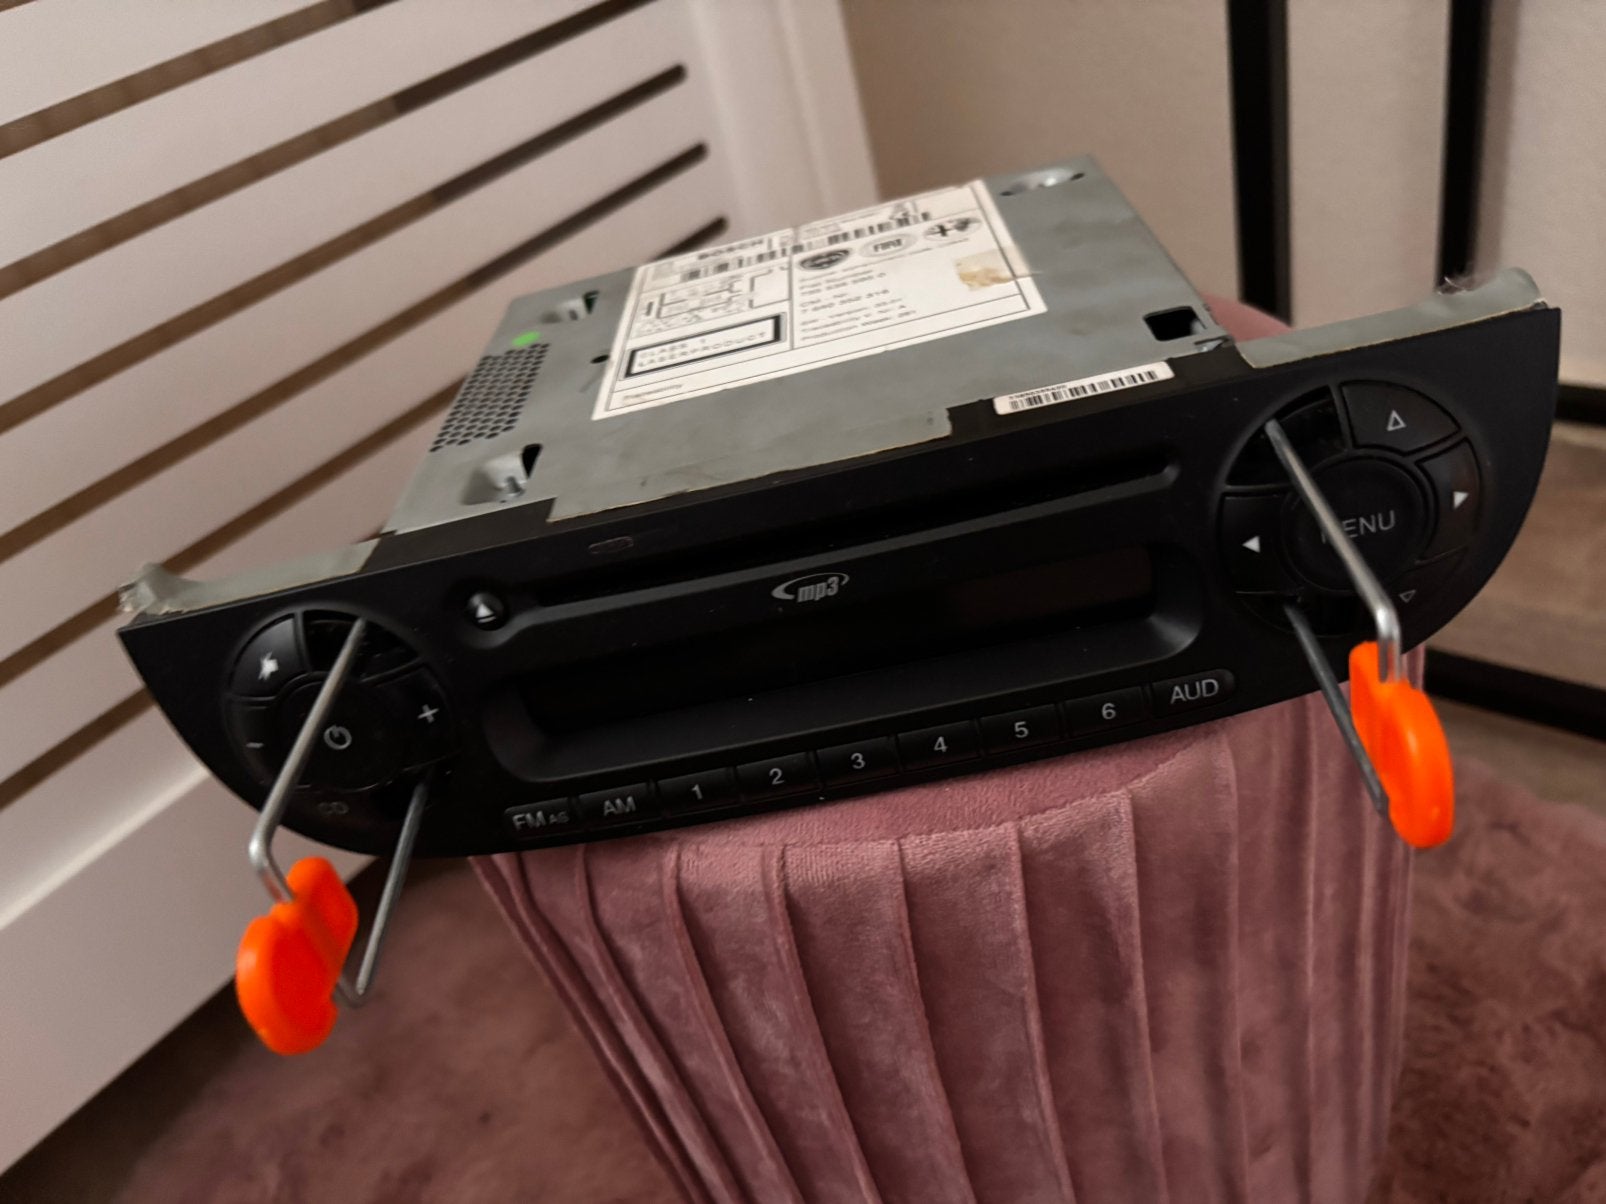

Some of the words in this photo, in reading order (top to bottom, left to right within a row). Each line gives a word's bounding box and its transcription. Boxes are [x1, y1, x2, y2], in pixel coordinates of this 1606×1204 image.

[1321, 510, 1396, 544] ENU
[796, 576, 840, 602] mp3
[1169, 678, 1220, 704] AUD
[1101, 703, 1116, 720] 6
[1014, 721, 1029, 738] 5
[933, 736, 949, 753] 4
[850, 752, 866, 769] 3
[769, 768, 785, 785] 2
[691, 784, 703, 800] 1
[603, 796, 637, 816] AM
[512, 811, 547, 830] FM
